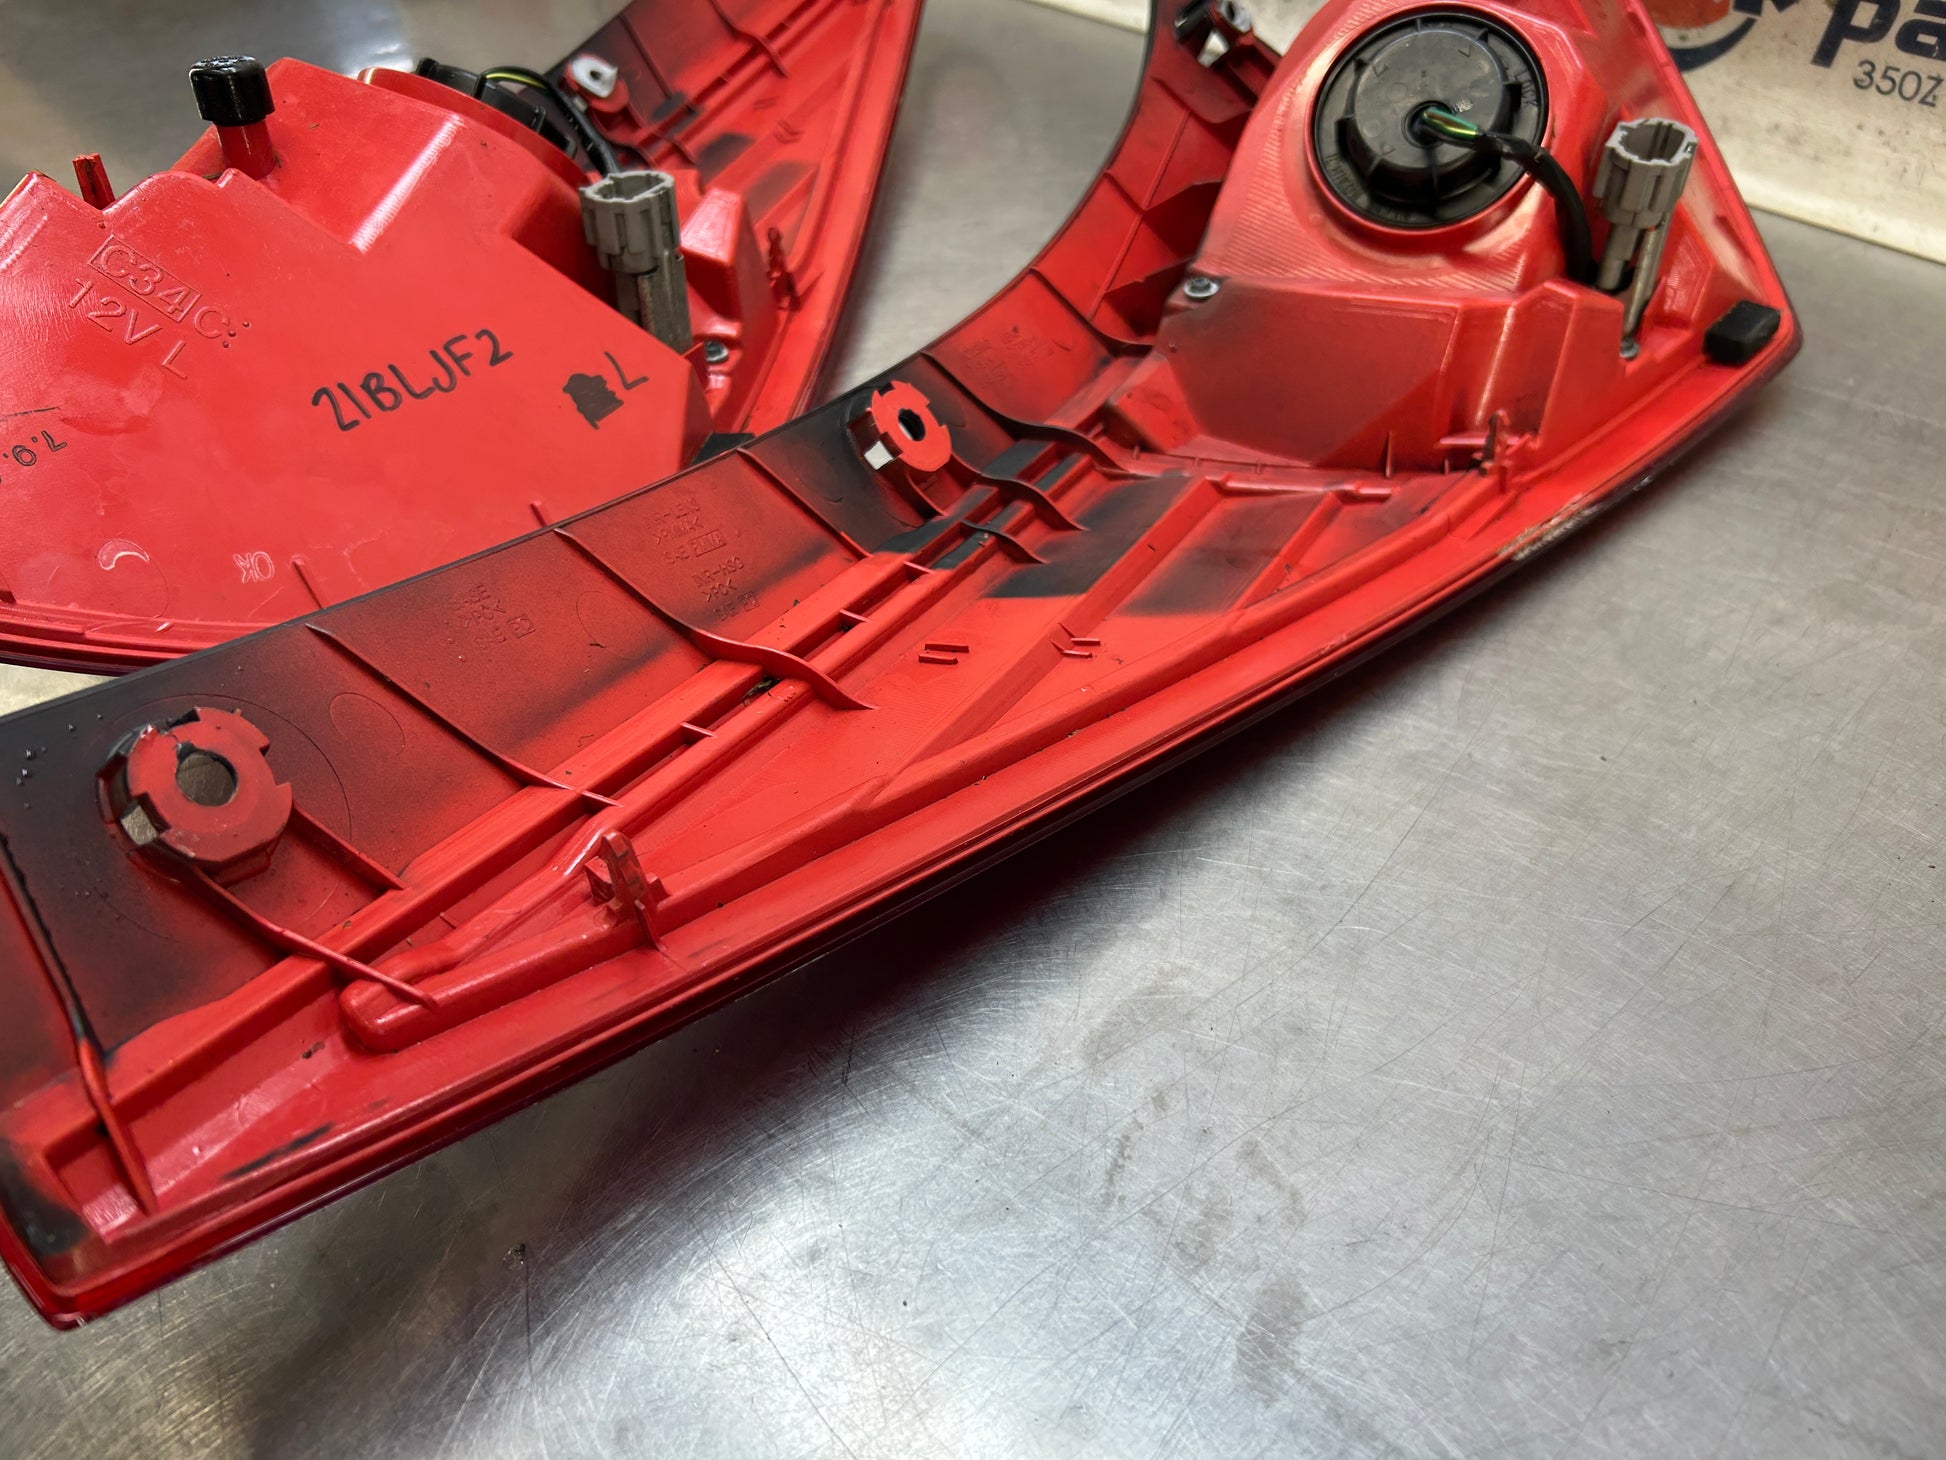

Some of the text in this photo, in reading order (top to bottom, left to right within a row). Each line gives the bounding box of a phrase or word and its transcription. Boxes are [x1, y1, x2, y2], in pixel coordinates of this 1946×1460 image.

[1853, 60, 1944, 107] 350Z
[69, 277, 188, 381] 12V L
[312, 329, 513, 431] 21BLJF2
[604, 351, 649, 391] L
[0, 430, 67, 468] 7.9.
